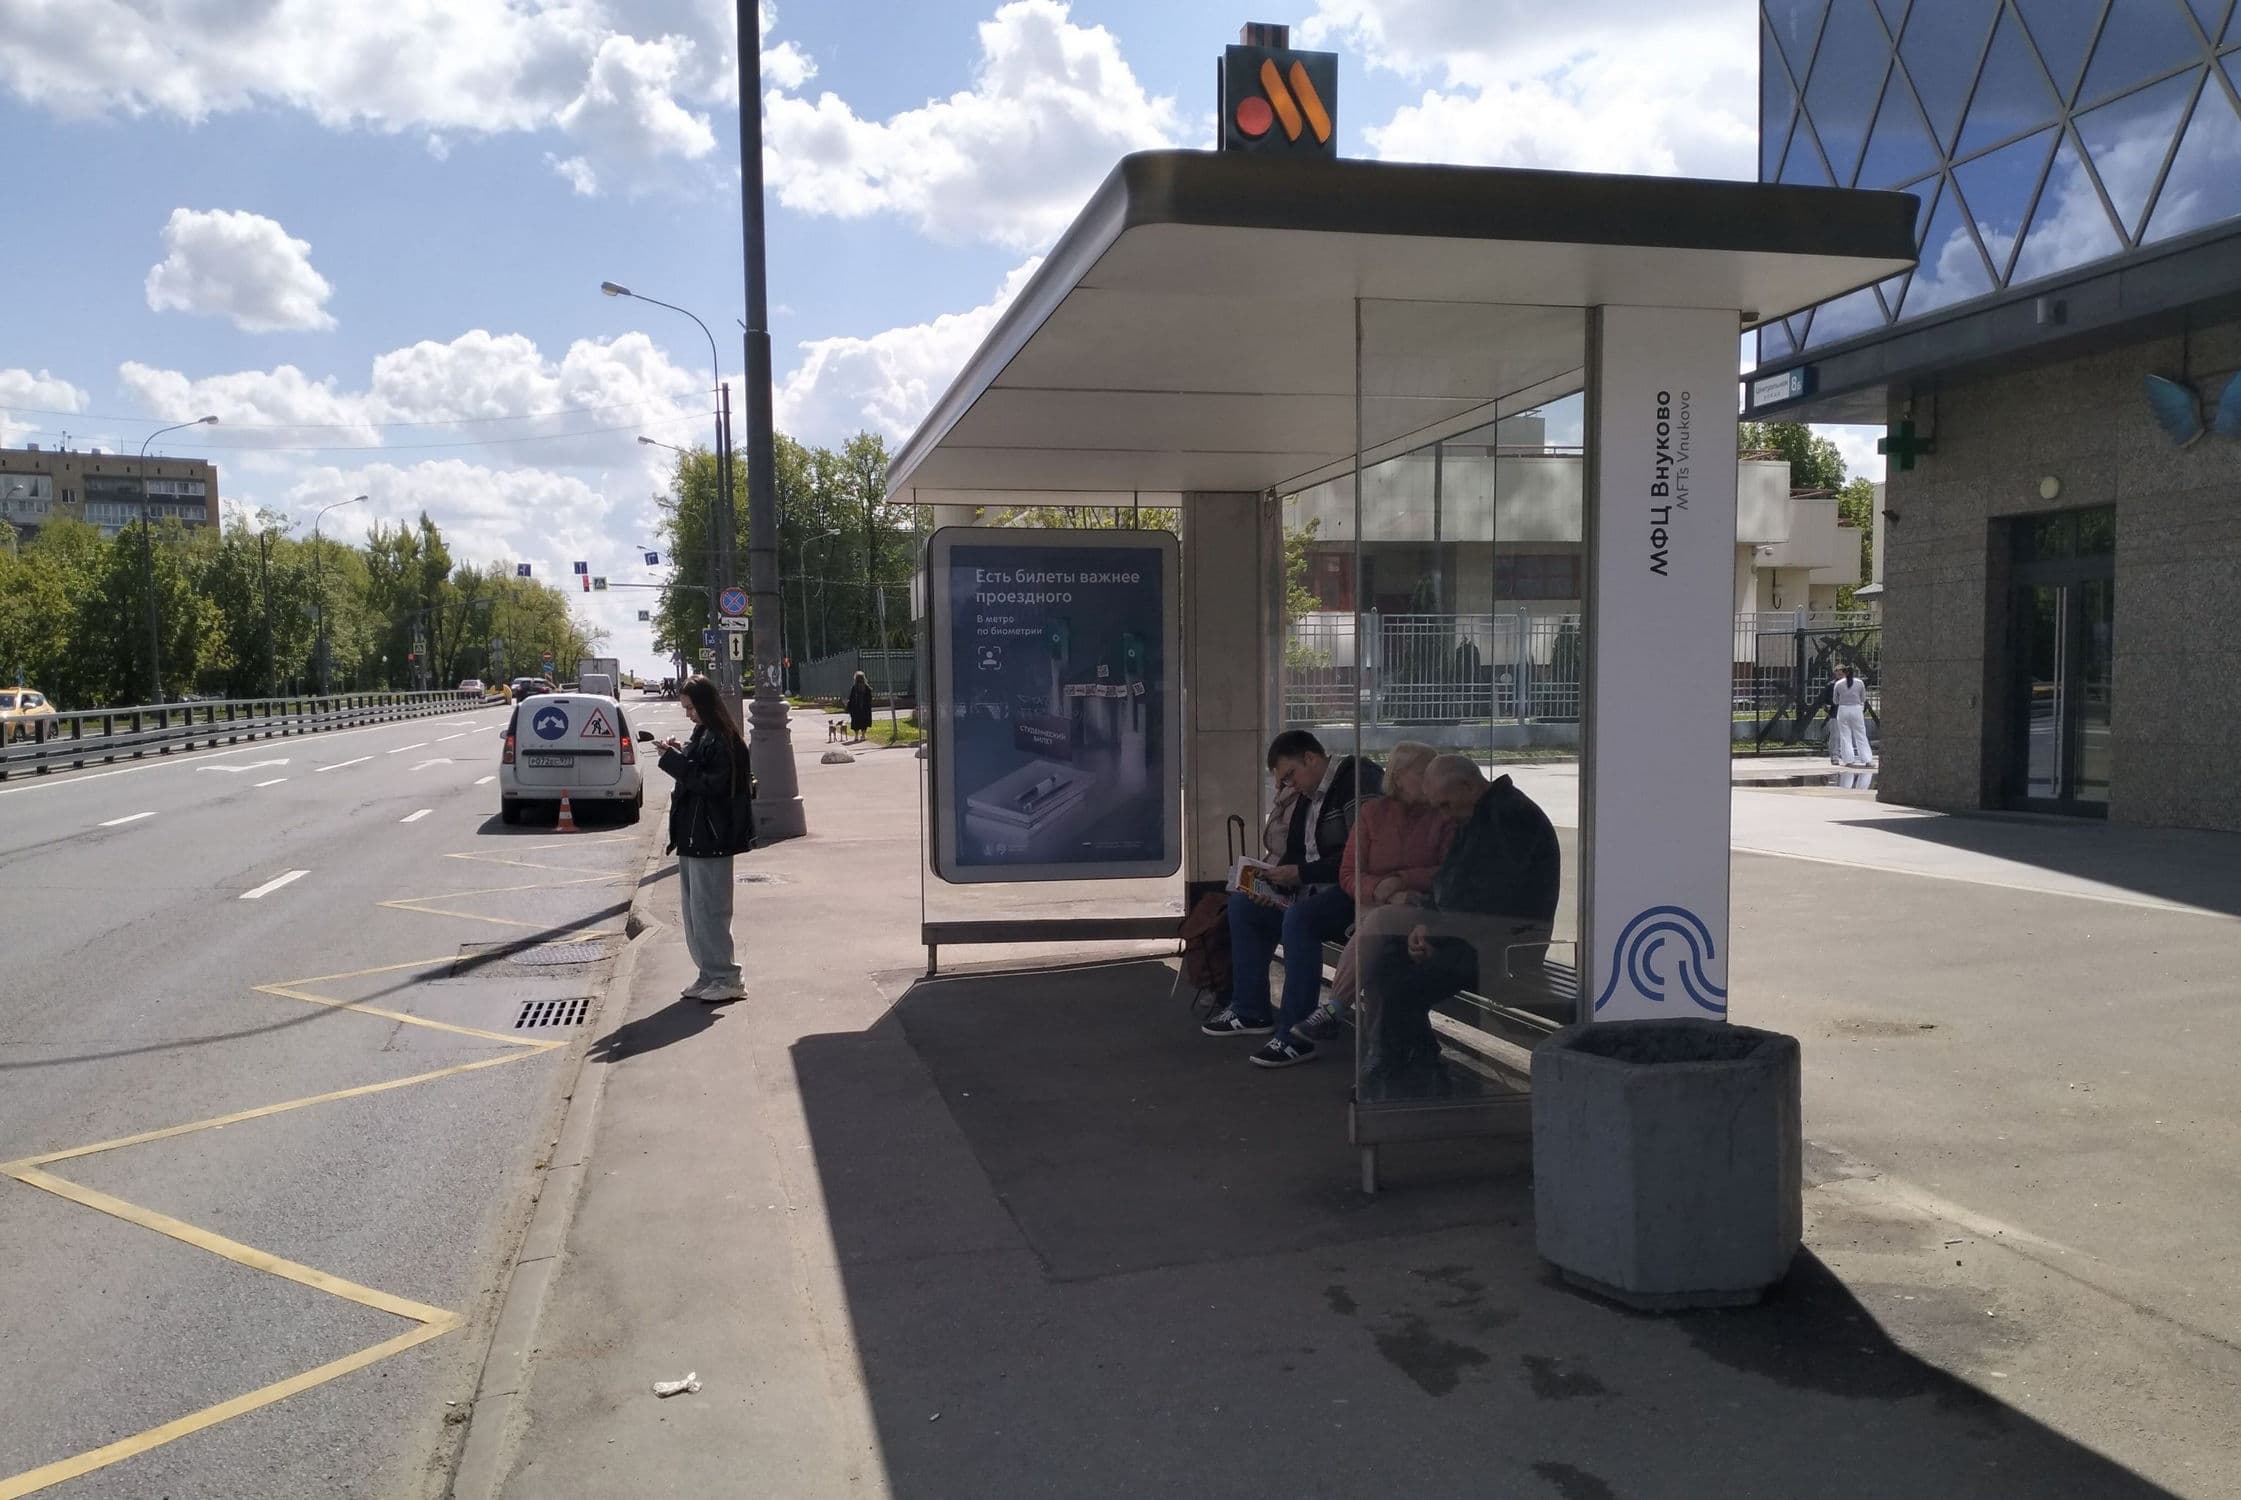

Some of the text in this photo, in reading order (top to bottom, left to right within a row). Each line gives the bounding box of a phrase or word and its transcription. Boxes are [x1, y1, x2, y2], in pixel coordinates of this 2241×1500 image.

[1677, 391, 1691, 510] MFTs Vnukovo
[1650, 390, 1674, 576] МФЦ Внуково
[976, 569, 1140, 583] Есть билеты важнее
[976, 593, 1072, 605] проездного
[977, 615, 1014, 624] В метро
[991, 627, 1042, 636] биометрии
